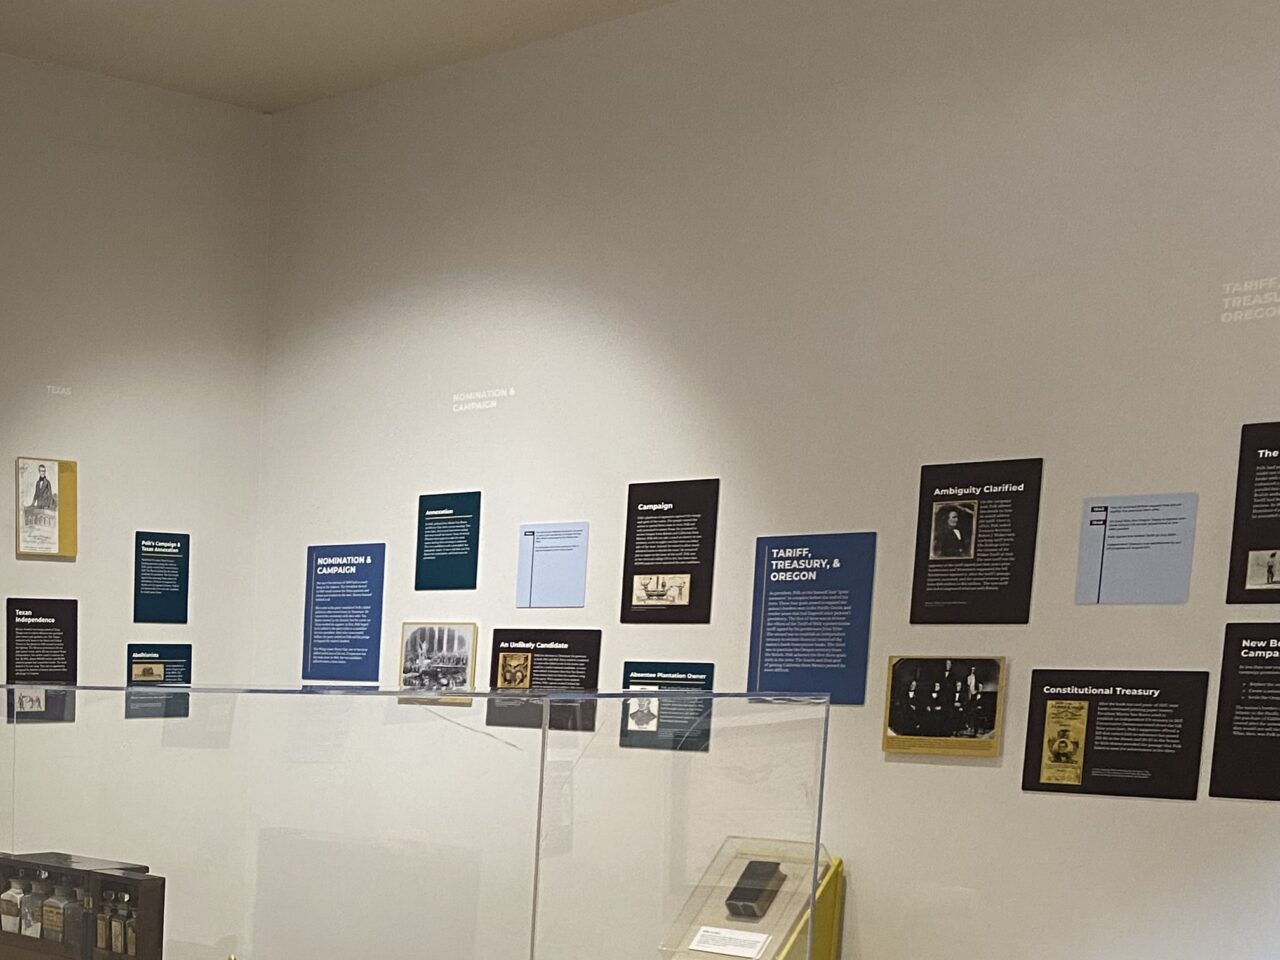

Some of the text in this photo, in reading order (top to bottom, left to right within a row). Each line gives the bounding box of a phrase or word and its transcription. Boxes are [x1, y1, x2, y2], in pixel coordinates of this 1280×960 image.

[453, 388, 507, 402] NOMINATION
[453, 400, 497, 412] CAMPAIGN
[1258, 450, 1279, 458] The
[934, 483, 1024, 496] Ambiguity Clarified
[638, 502, 673, 511] Campaign
[772, 548, 812, 558] TARIFF,
[317, 556, 364, 565] NOMINATION
[771, 559, 841, 570] TREASURY, &
[317, 566, 356, 574] CAMPAIGN
[770, 571, 816, 581] OREGON
[1242, 639, 1267, 647] New
[1043, 686, 1160, 697] Constitutional Treasury
